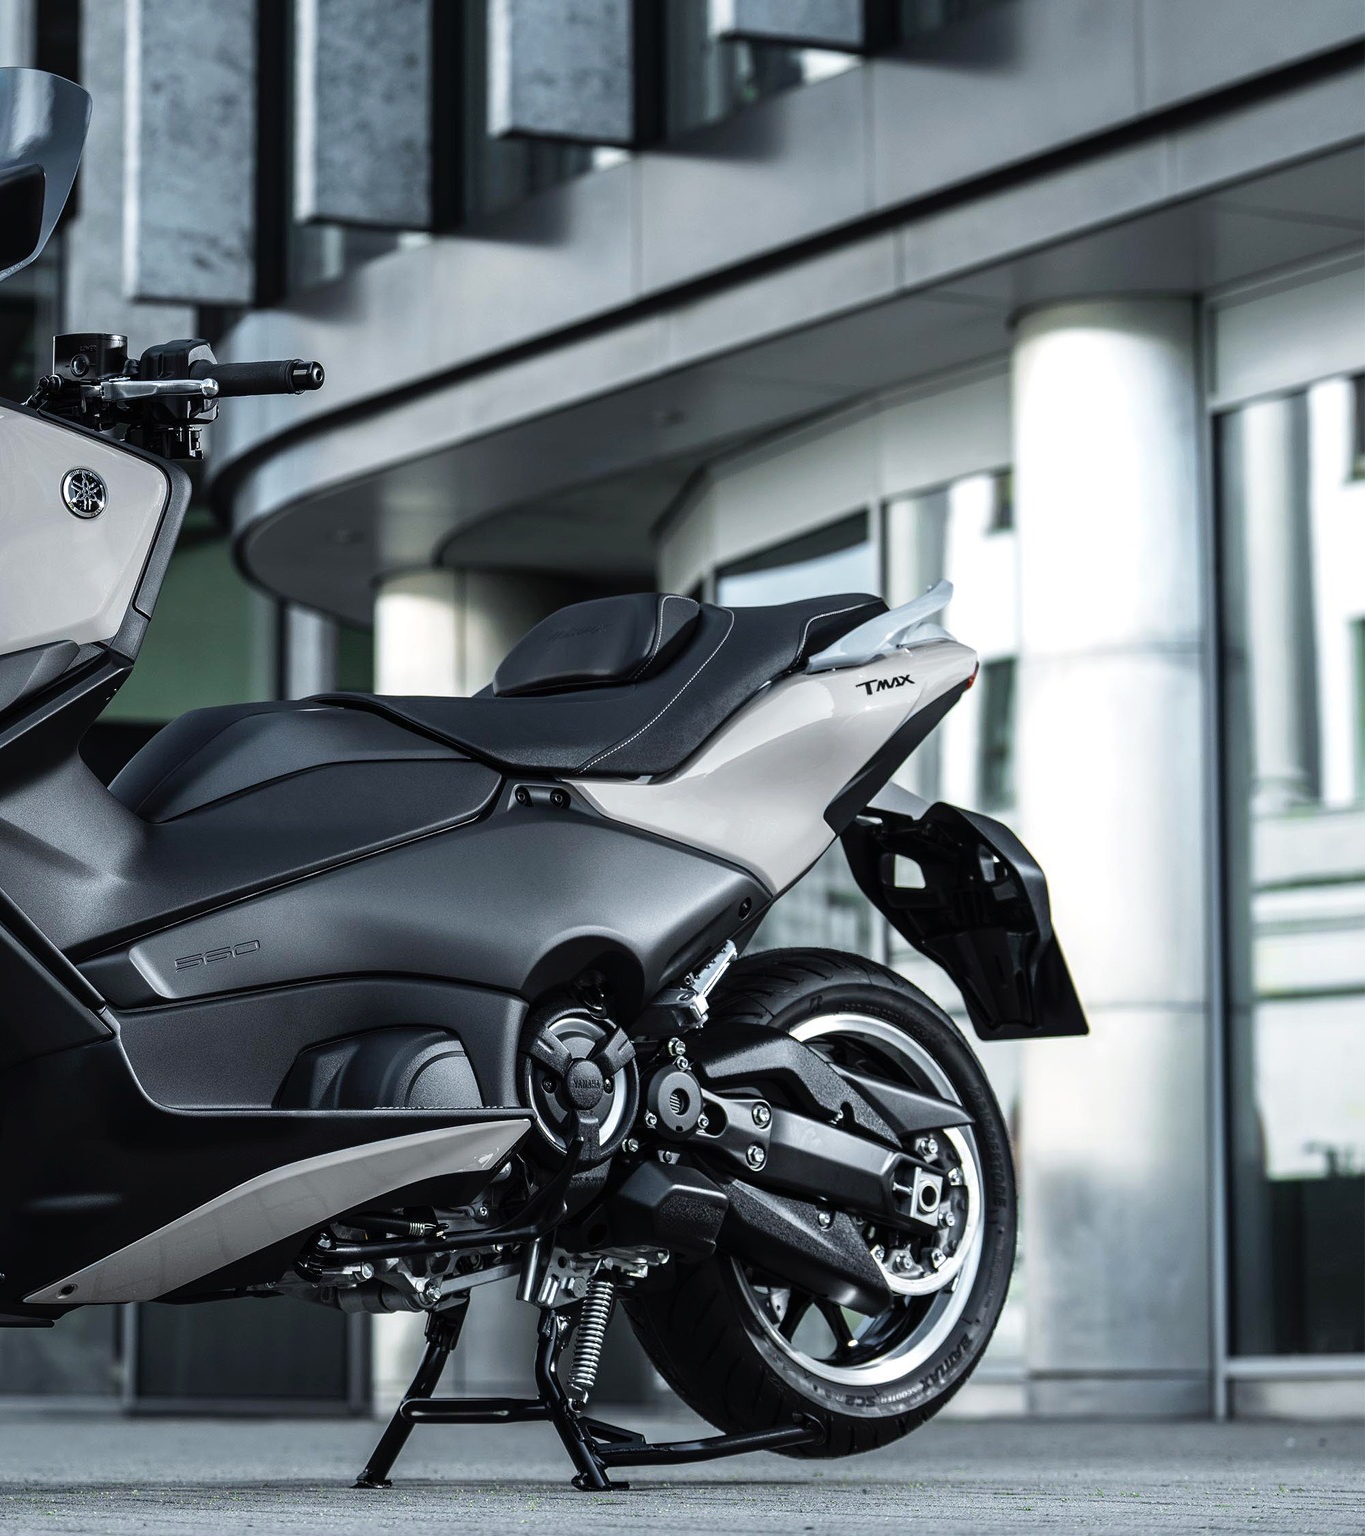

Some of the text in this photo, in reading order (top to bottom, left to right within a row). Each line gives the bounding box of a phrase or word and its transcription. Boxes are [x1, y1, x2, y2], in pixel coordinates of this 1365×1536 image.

[855, 674, 915, 696] TMAX
[175, 938, 261, 973] 560
[573, 1080, 601, 1089] YAMAHA
[918, 1332, 974, 1397] BATTLAX
[844, 1394, 876, 1407] SC2
